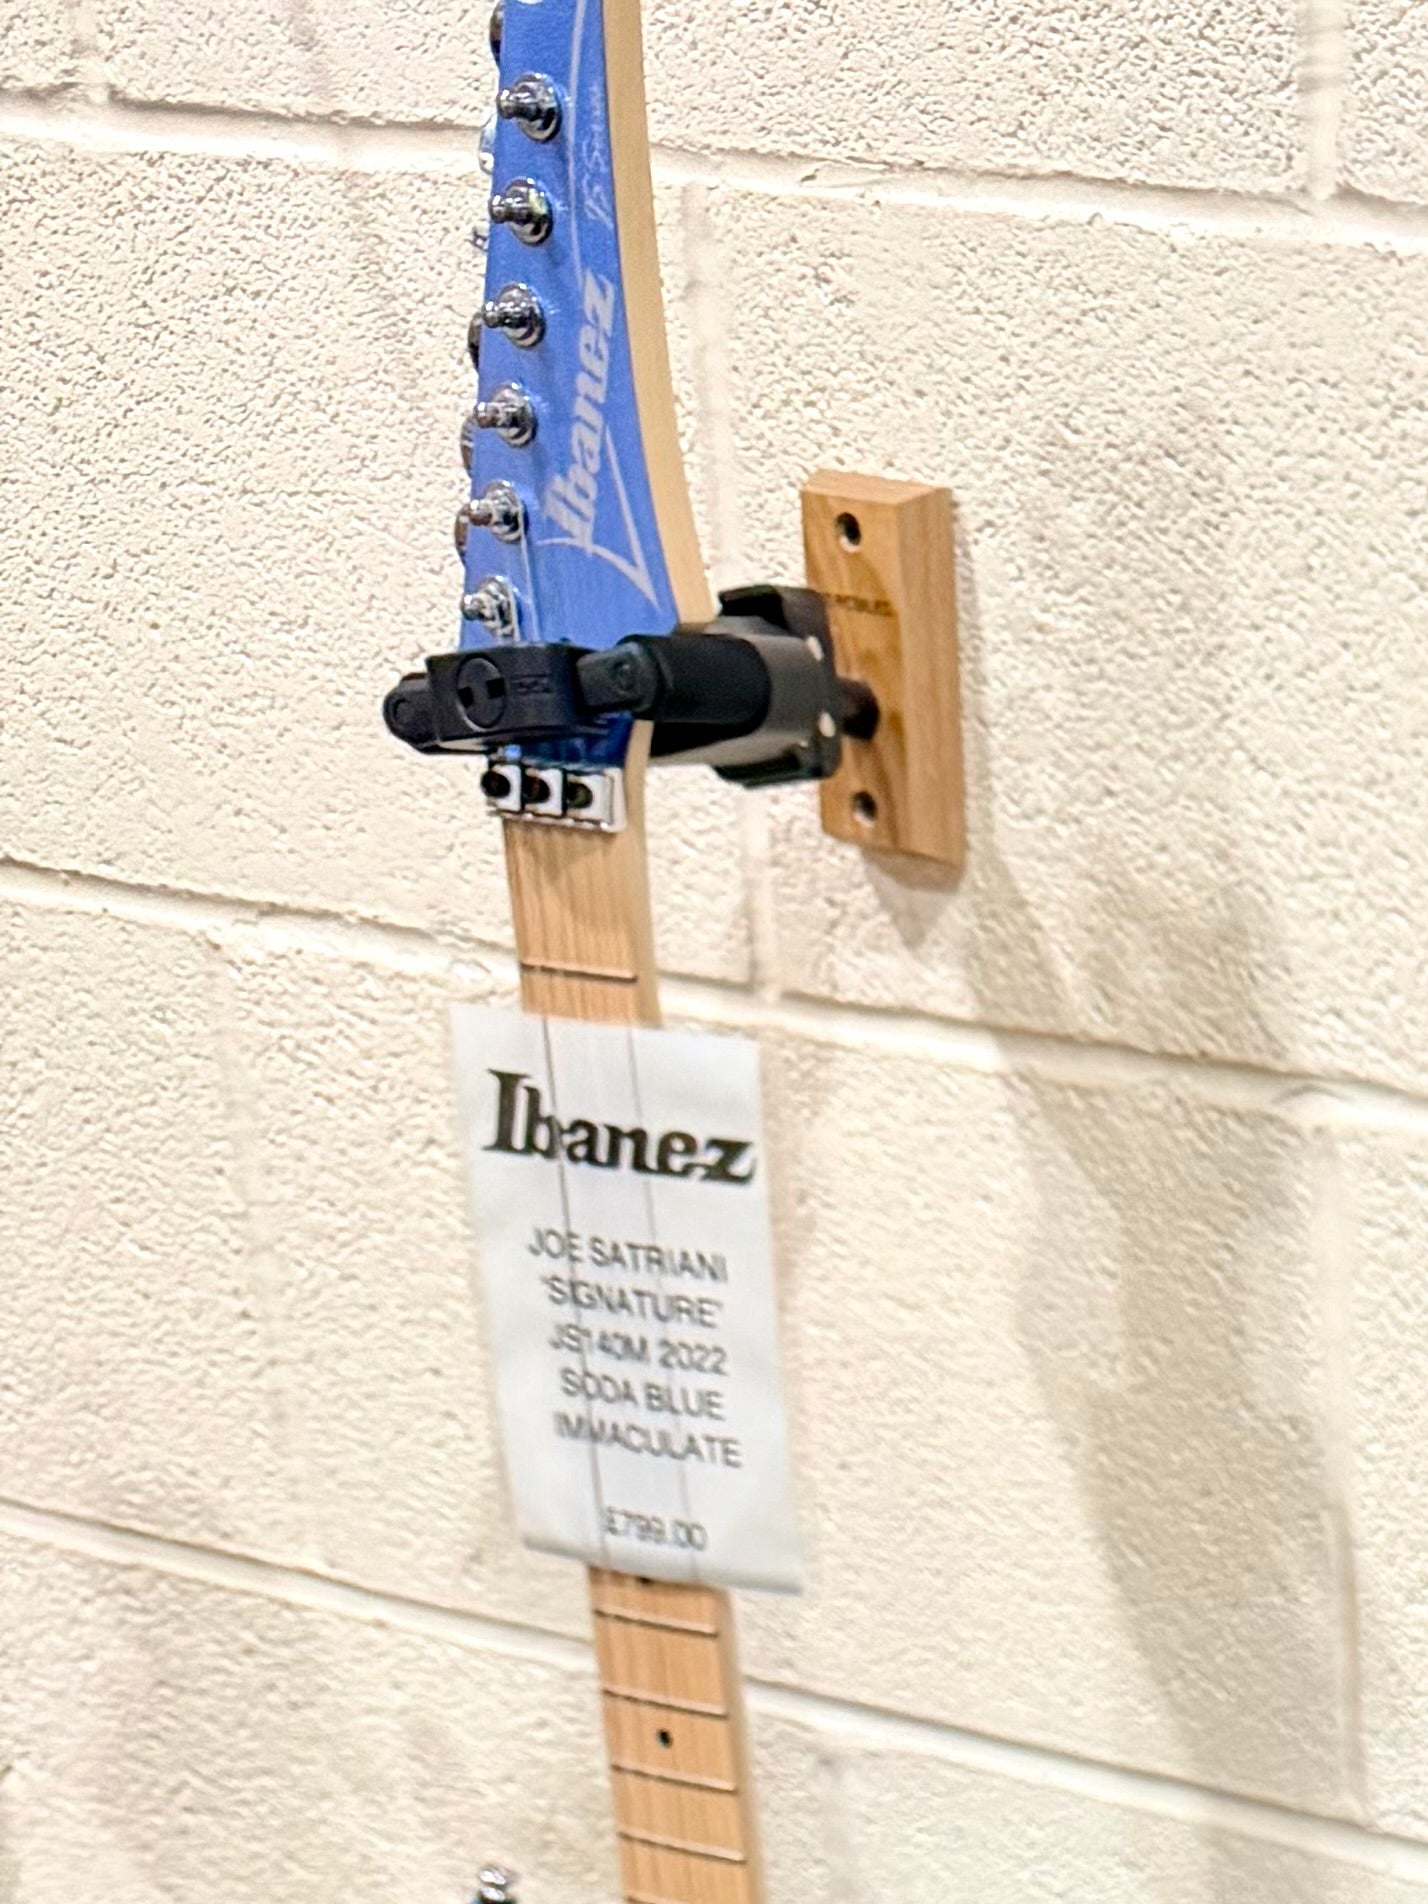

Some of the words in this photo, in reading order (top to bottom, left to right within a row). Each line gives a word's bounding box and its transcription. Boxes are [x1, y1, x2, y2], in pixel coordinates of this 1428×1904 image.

[543, 267, 615, 556] Ibanez
[481, 1067, 757, 1185] Ibanez
[527, 1226, 583, 1264] JOE
[588, 1235, 728, 1284] SATRIANI
[657, 1337, 729, 1377] 2022
[559, 1367, 639, 1406] SODA
[644, 1381, 727, 1423] BLUE
[554, 1410, 744, 1469] IMMACULATE
